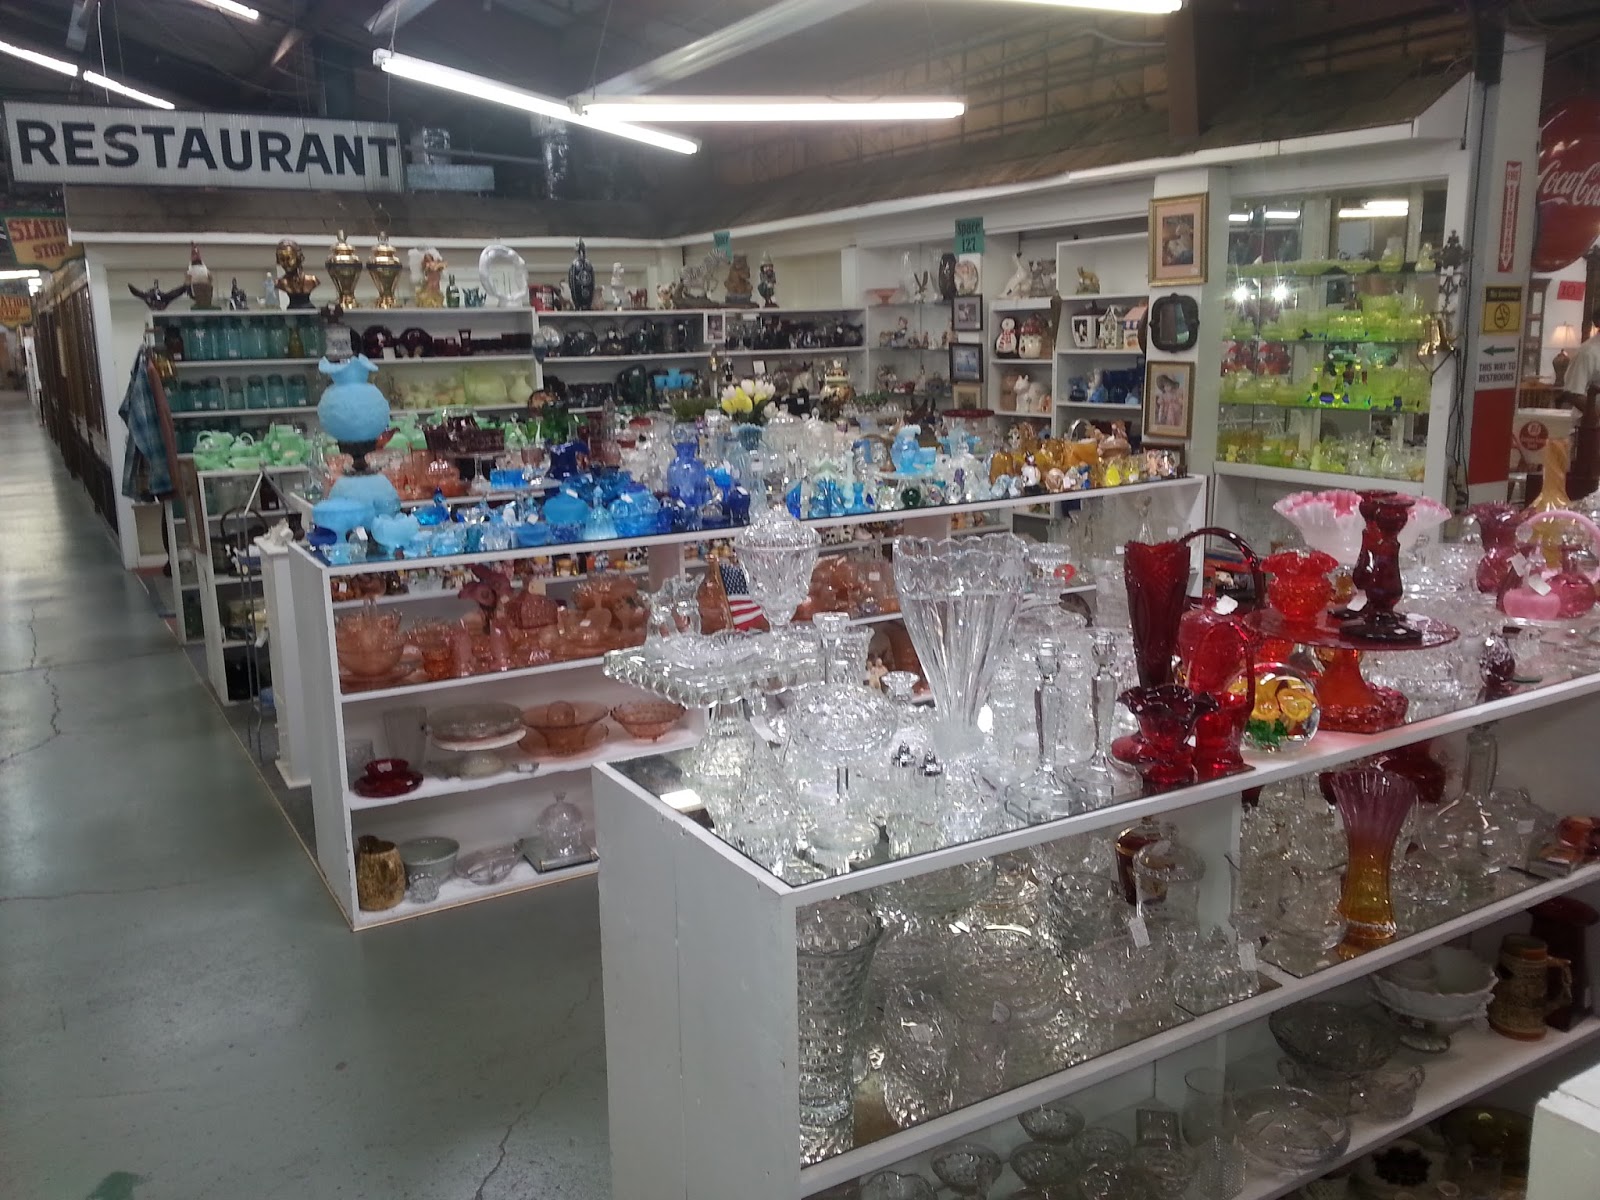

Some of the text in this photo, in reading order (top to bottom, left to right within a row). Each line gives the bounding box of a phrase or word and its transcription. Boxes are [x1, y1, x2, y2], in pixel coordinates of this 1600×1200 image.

[16, 119, 396, 177] RESTAURANT
[1506, 171, 1519, 181] FIRE
[33, 242, 66, 259] STOP
[962, 237, 976, 252] 127
[1479, 361, 1516, 372] THIS WAY TO
[1479, 373, 1514, 383] RESTROOMS
